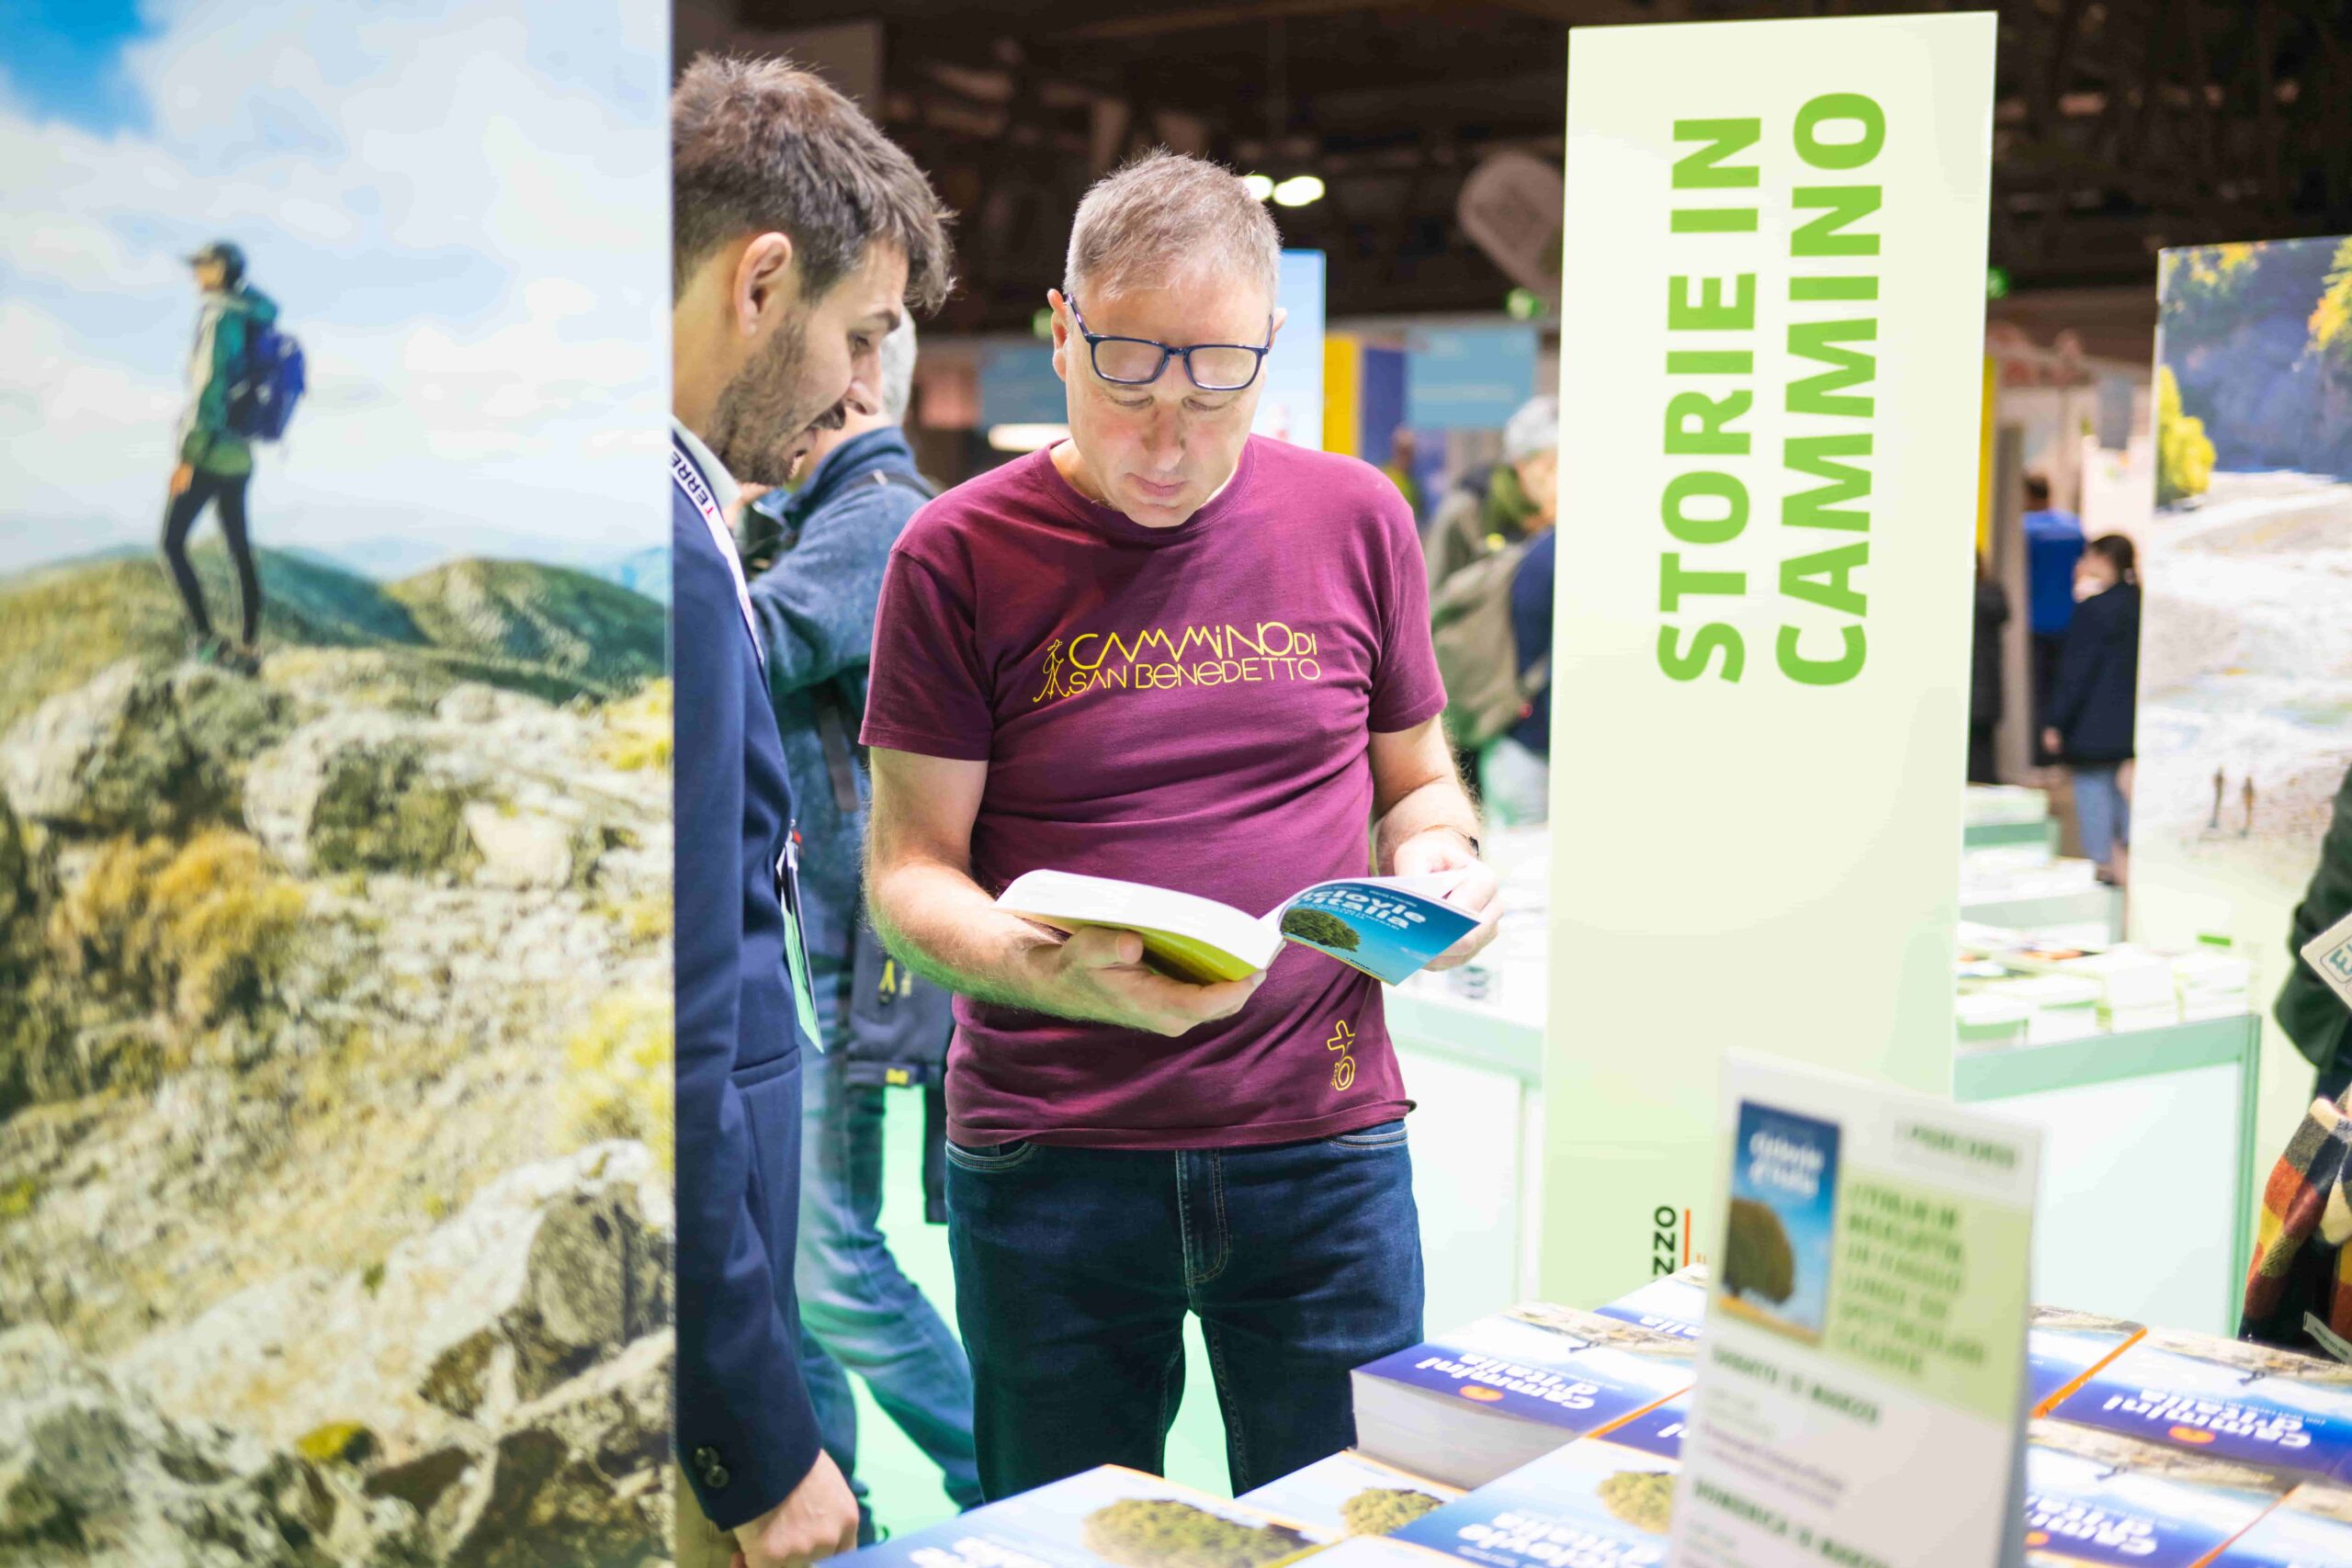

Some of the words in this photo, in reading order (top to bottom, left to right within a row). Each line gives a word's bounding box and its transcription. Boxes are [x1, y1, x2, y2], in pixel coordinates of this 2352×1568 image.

[1670, 117, 1762, 233] IN
[1775, 92, 1886, 686] CAMMINO
[671, 450, 715, 519] TERRE
[1657, 273, 1757, 683] STORIE
[1068, 664, 1127, 694] SAN
[1291, 889, 1427, 924] iclovie
[1653, 1205, 1677, 1277] ZZO
[1639, 1314, 1702, 1337] alia
[2024, 1508, 2158, 1556] Camm
